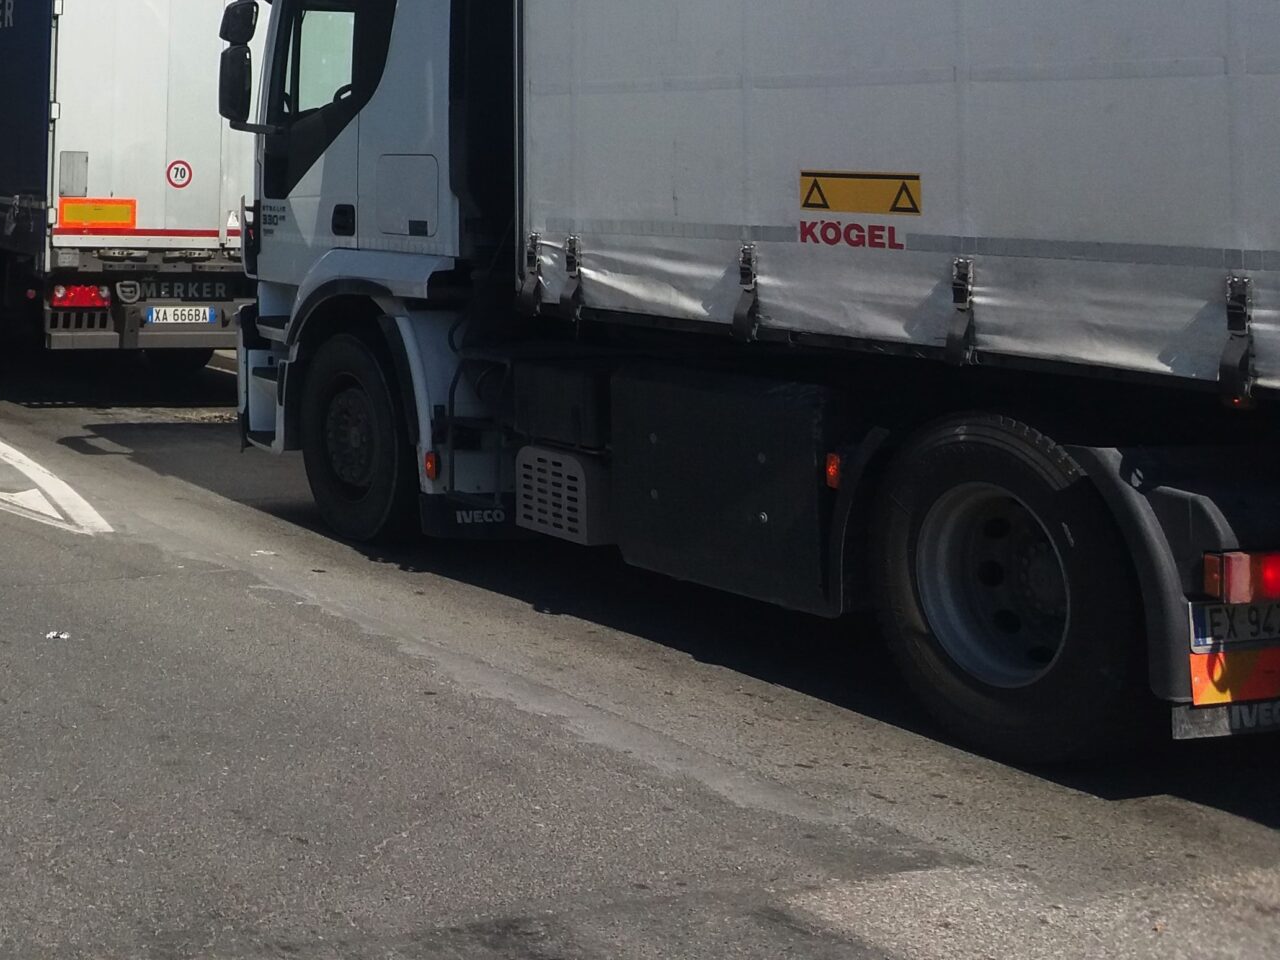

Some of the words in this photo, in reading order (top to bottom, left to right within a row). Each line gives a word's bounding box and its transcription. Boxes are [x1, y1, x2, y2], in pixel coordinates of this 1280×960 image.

[174, 167, 186, 179] 70
[800, 219, 904, 250] KÖGEL
[140, 282, 227, 298] MERKER
[154, 308, 168, 322] XA
[172, 308, 208, 322] 666BA
[455, 509, 505, 524] IVECO
[1248, 604, 1280, 637] 94
